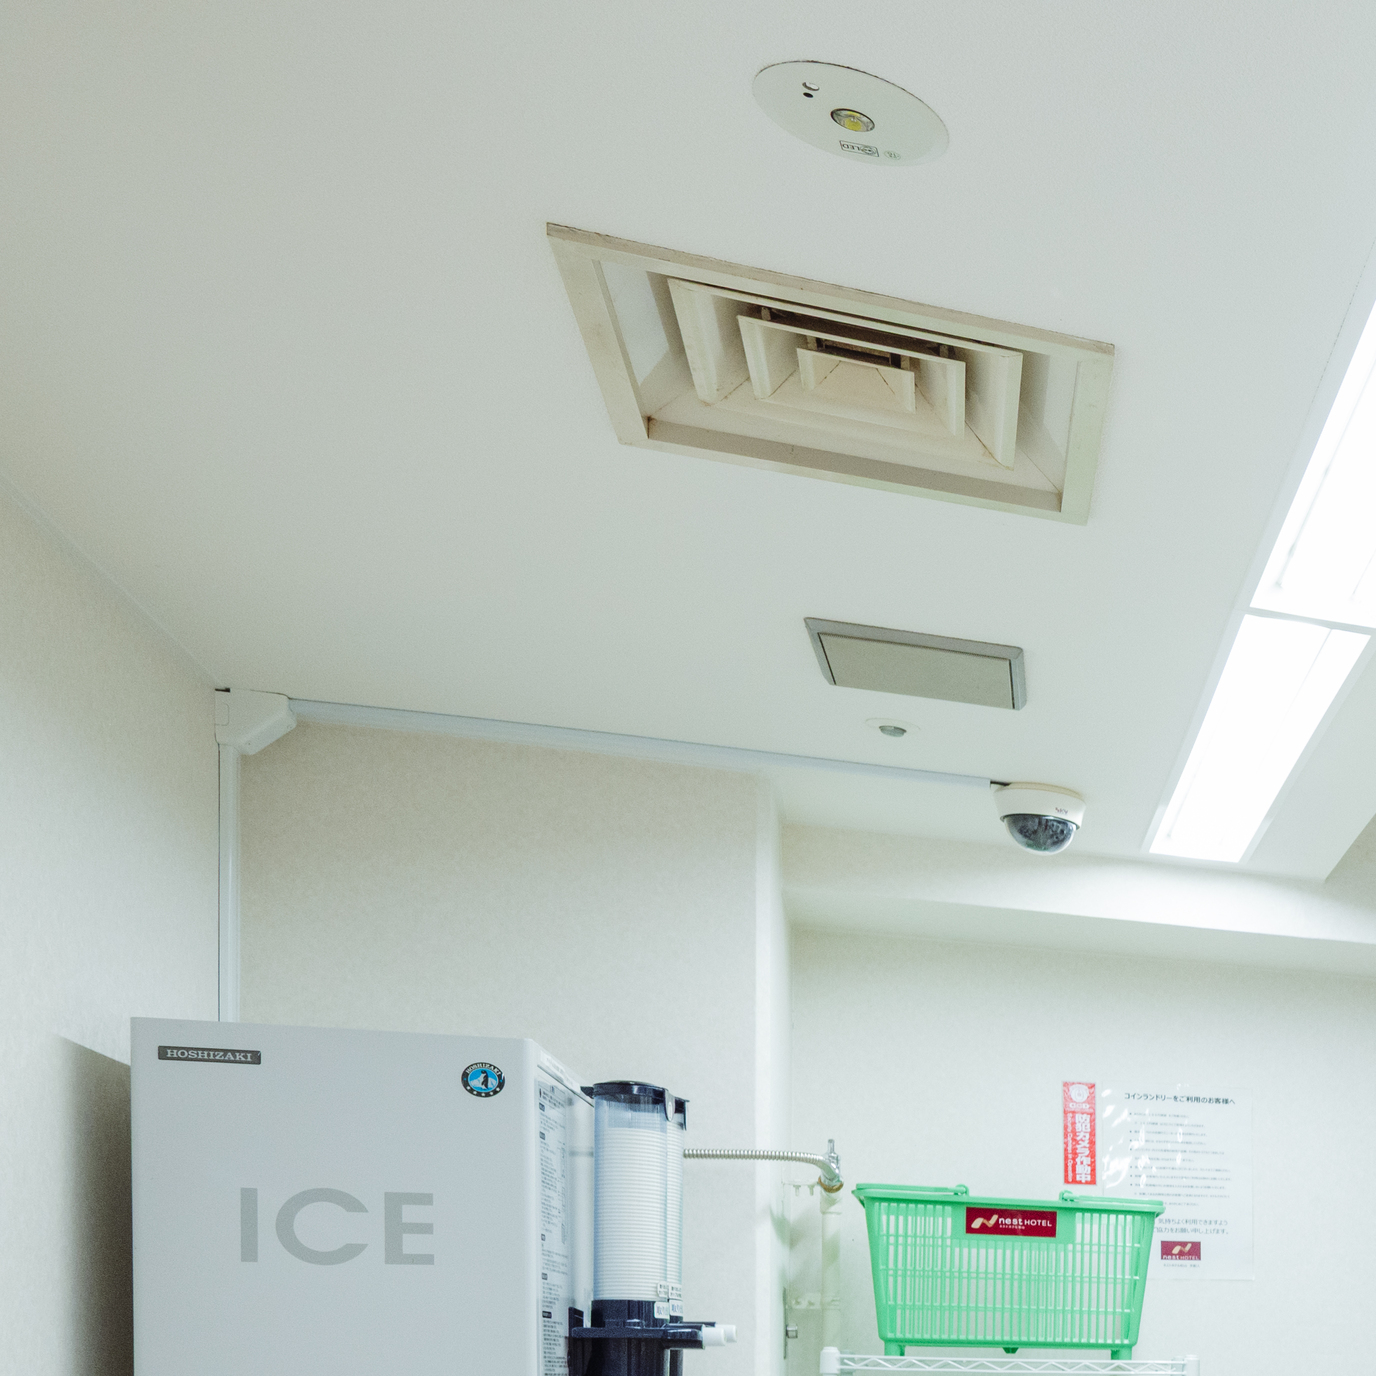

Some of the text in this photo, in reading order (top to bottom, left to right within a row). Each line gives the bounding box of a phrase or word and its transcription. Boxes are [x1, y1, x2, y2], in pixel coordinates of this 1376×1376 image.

[165, 1048, 253, 1063] HOSHIZAKI
[1123, 1092, 1236, 1106] コインランドリーをご利用のお客様へ
[1075, 1113, 1091, 1183] 防犯カメラ作動中
[240, 1186, 435, 1267] ICE
[998, 1217, 1024, 1226] nest
[1024, 1218, 1053, 1227] HOTEL
